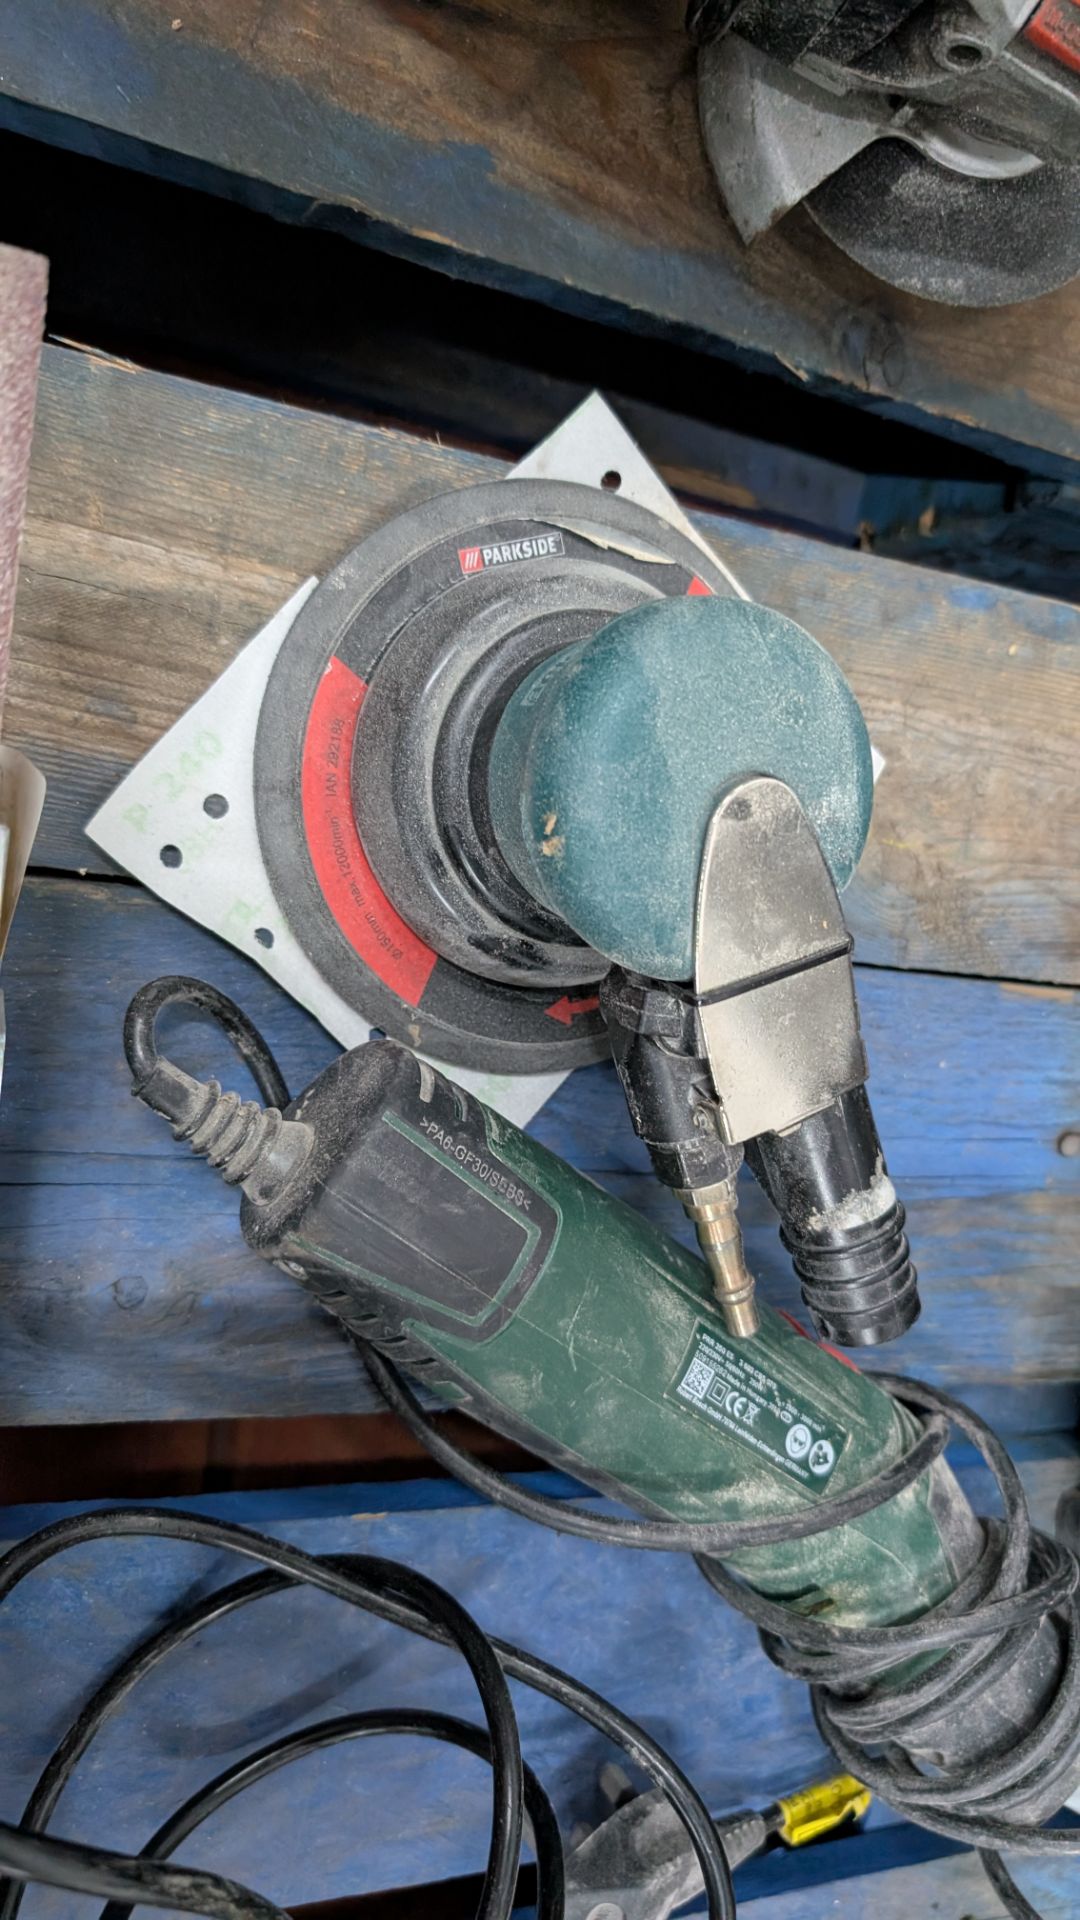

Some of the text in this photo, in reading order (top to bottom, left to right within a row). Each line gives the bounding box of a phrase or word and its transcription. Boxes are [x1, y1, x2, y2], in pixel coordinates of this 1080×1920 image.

[482, 538, 557, 565] PARKSIDE
[326, 718, 345, 769] 292188
[325, 773, 338, 797] IAN
[692, 1395, 707, 1411] Bosch
